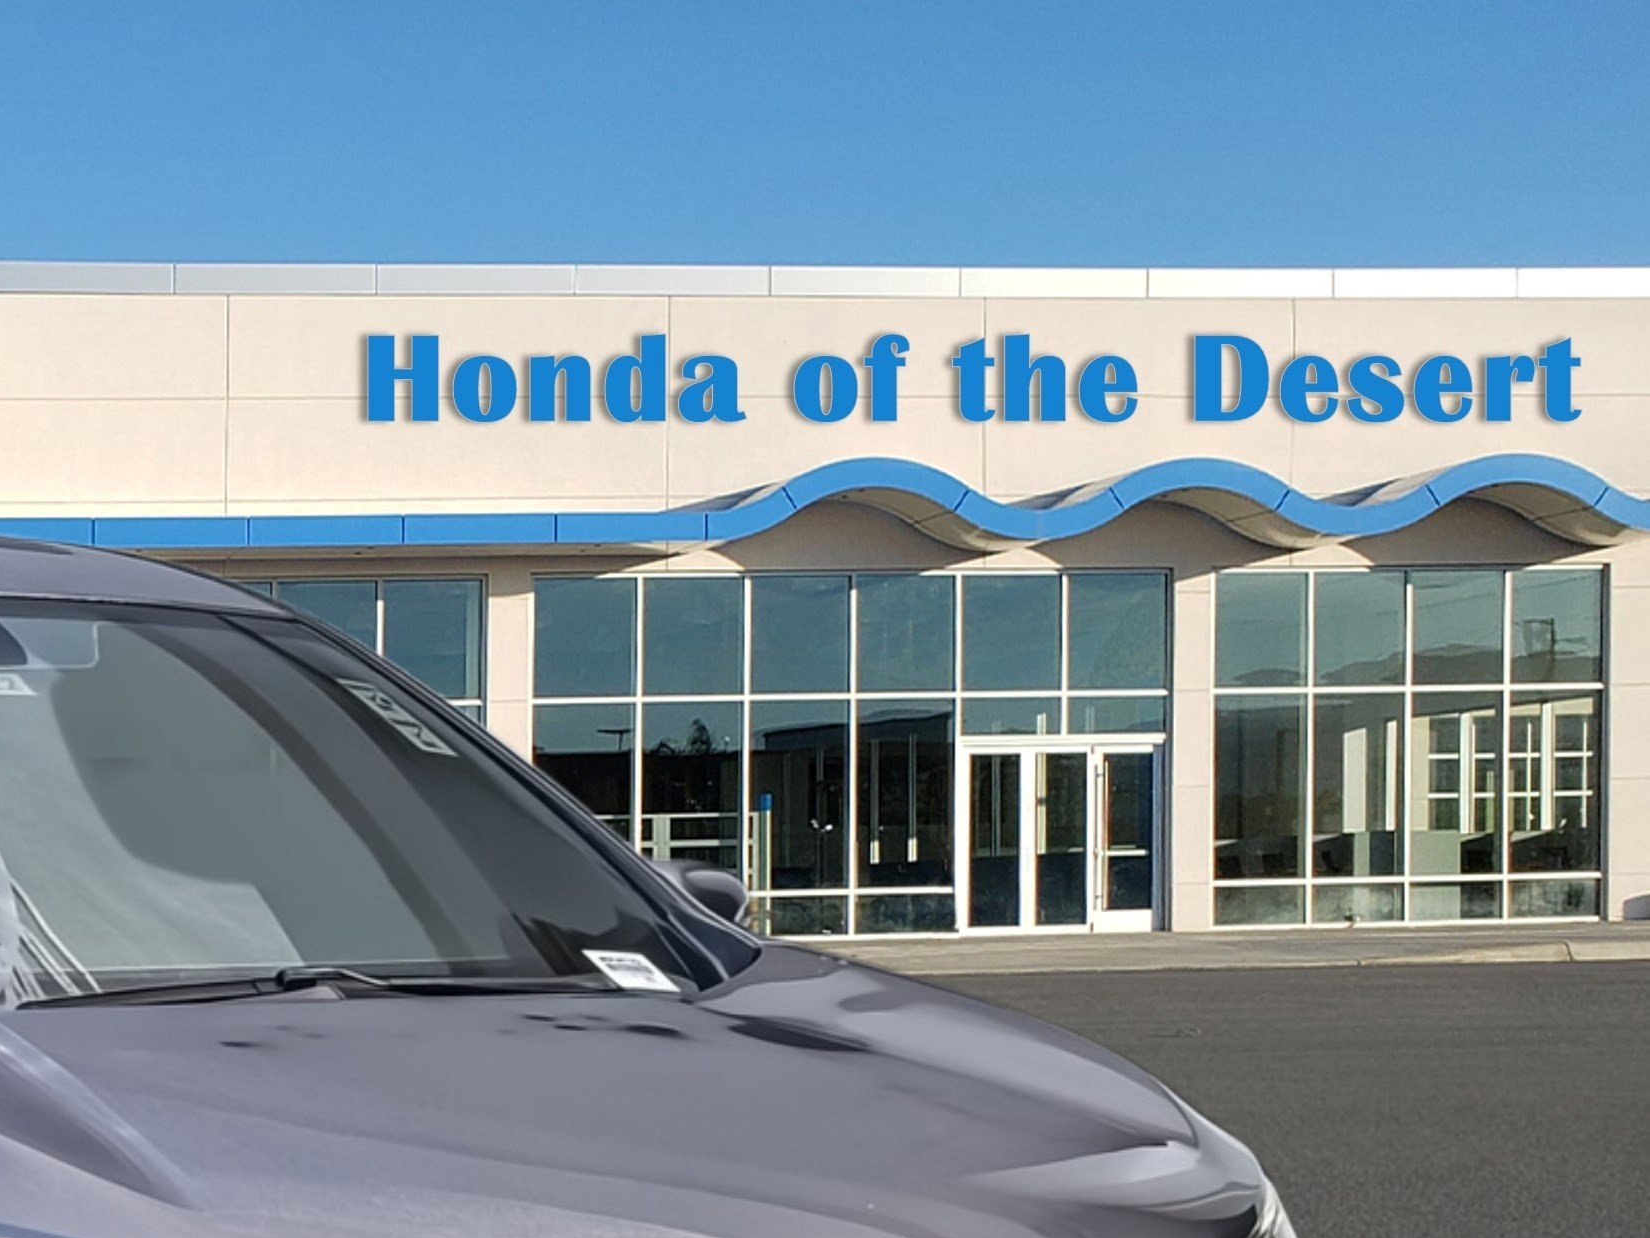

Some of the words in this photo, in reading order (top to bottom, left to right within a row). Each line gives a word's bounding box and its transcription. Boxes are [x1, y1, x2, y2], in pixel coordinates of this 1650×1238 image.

[365, 333, 747, 424] Honda
[793, 333, 911, 424] of
[952, 333, 1139, 424] the
[1194, 334, 1583, 424] Desert
